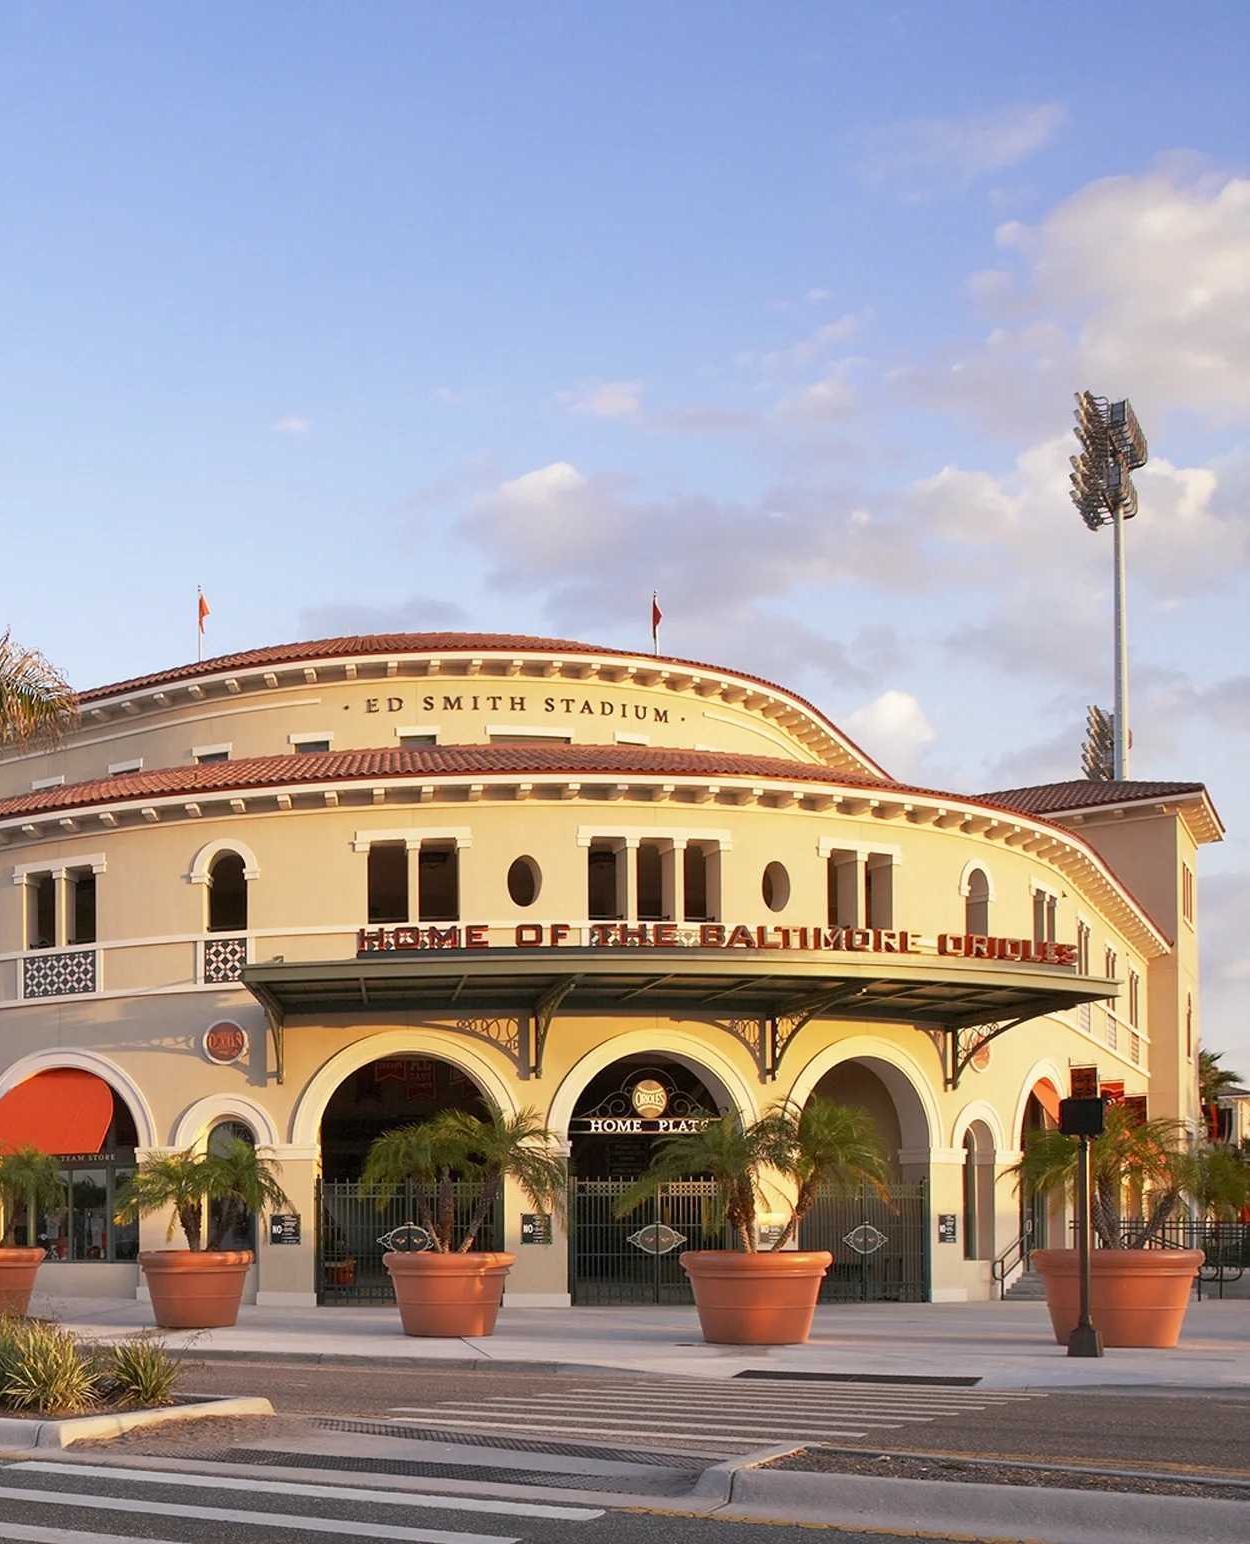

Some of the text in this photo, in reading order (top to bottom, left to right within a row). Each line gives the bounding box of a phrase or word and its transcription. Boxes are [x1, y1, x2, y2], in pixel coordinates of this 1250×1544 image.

[365, 695, 670, 724] ED SMITH STADIUM
[358, 923, 1079, 966] HOME OF THE BALTIMORE ORIOLES
[635, 1092, 665, 1107] ORIOLES
[590, 1120, 643, 1132] HOME
[88, 1153, 116, 1161] STORE
[272, 1224, 283, 1235] NO
[523, 1224, 533, 1234] NO
